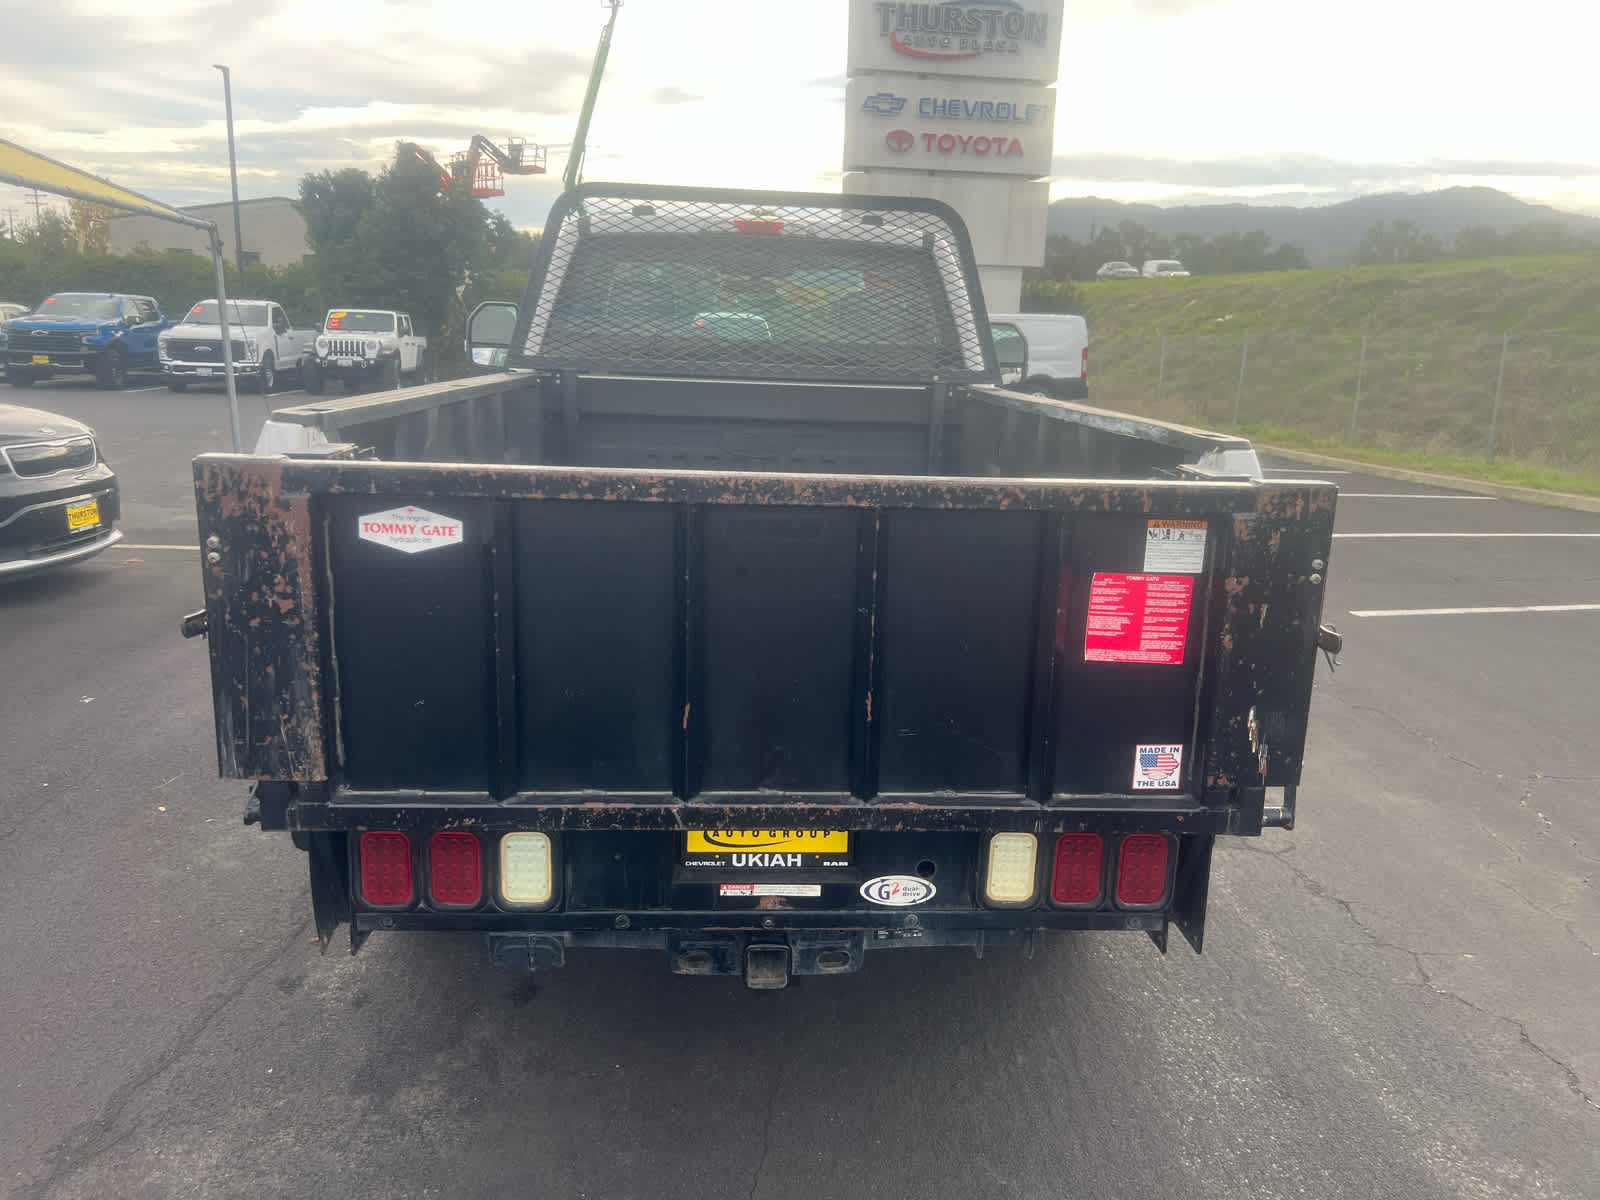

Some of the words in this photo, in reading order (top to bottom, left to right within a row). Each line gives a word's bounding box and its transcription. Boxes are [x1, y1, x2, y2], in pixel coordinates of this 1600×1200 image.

[877, 2, 1049, 42] THURSTON
[918, 97, 1050, 121] CHEVROLET
[921, 132, 1024, 157] TOYOTA
[362, 521, 416, 535] TOMMY
[421, 524, 456, 537] GATE
[1162, 520, 1202, 528] WARNING
[712, 830, 760, 838] AUTO
[769, 830, 831, 839] GROUP
[732, 853, 803, 868] UKIAH
